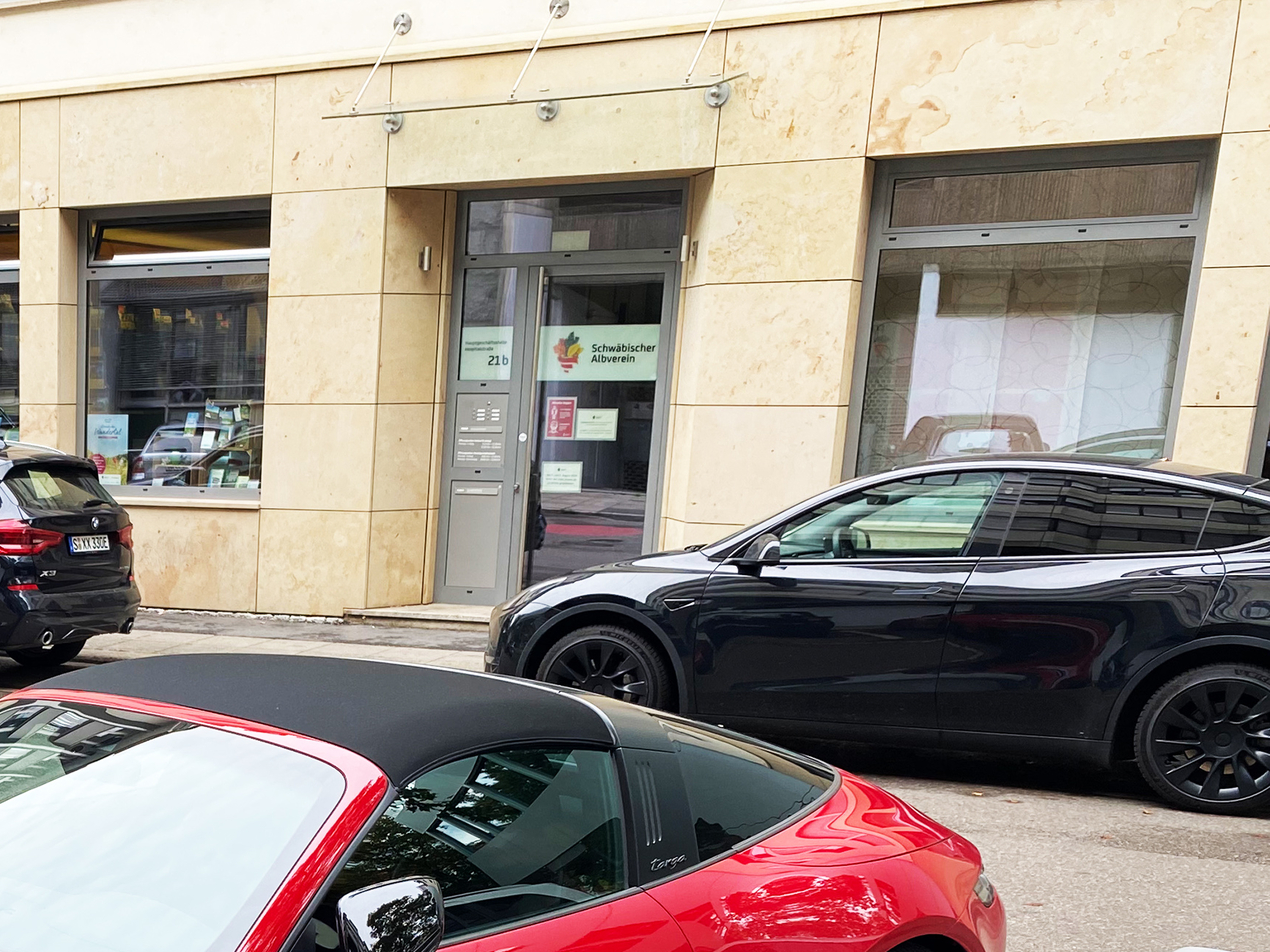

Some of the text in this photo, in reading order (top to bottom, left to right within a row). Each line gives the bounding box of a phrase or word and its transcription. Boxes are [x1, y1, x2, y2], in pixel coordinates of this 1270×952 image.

[591, 343, 656, 353] Schwäbischer
[591, 354, 636, 363] Albverein
[39, 570, 57, 578] X3
